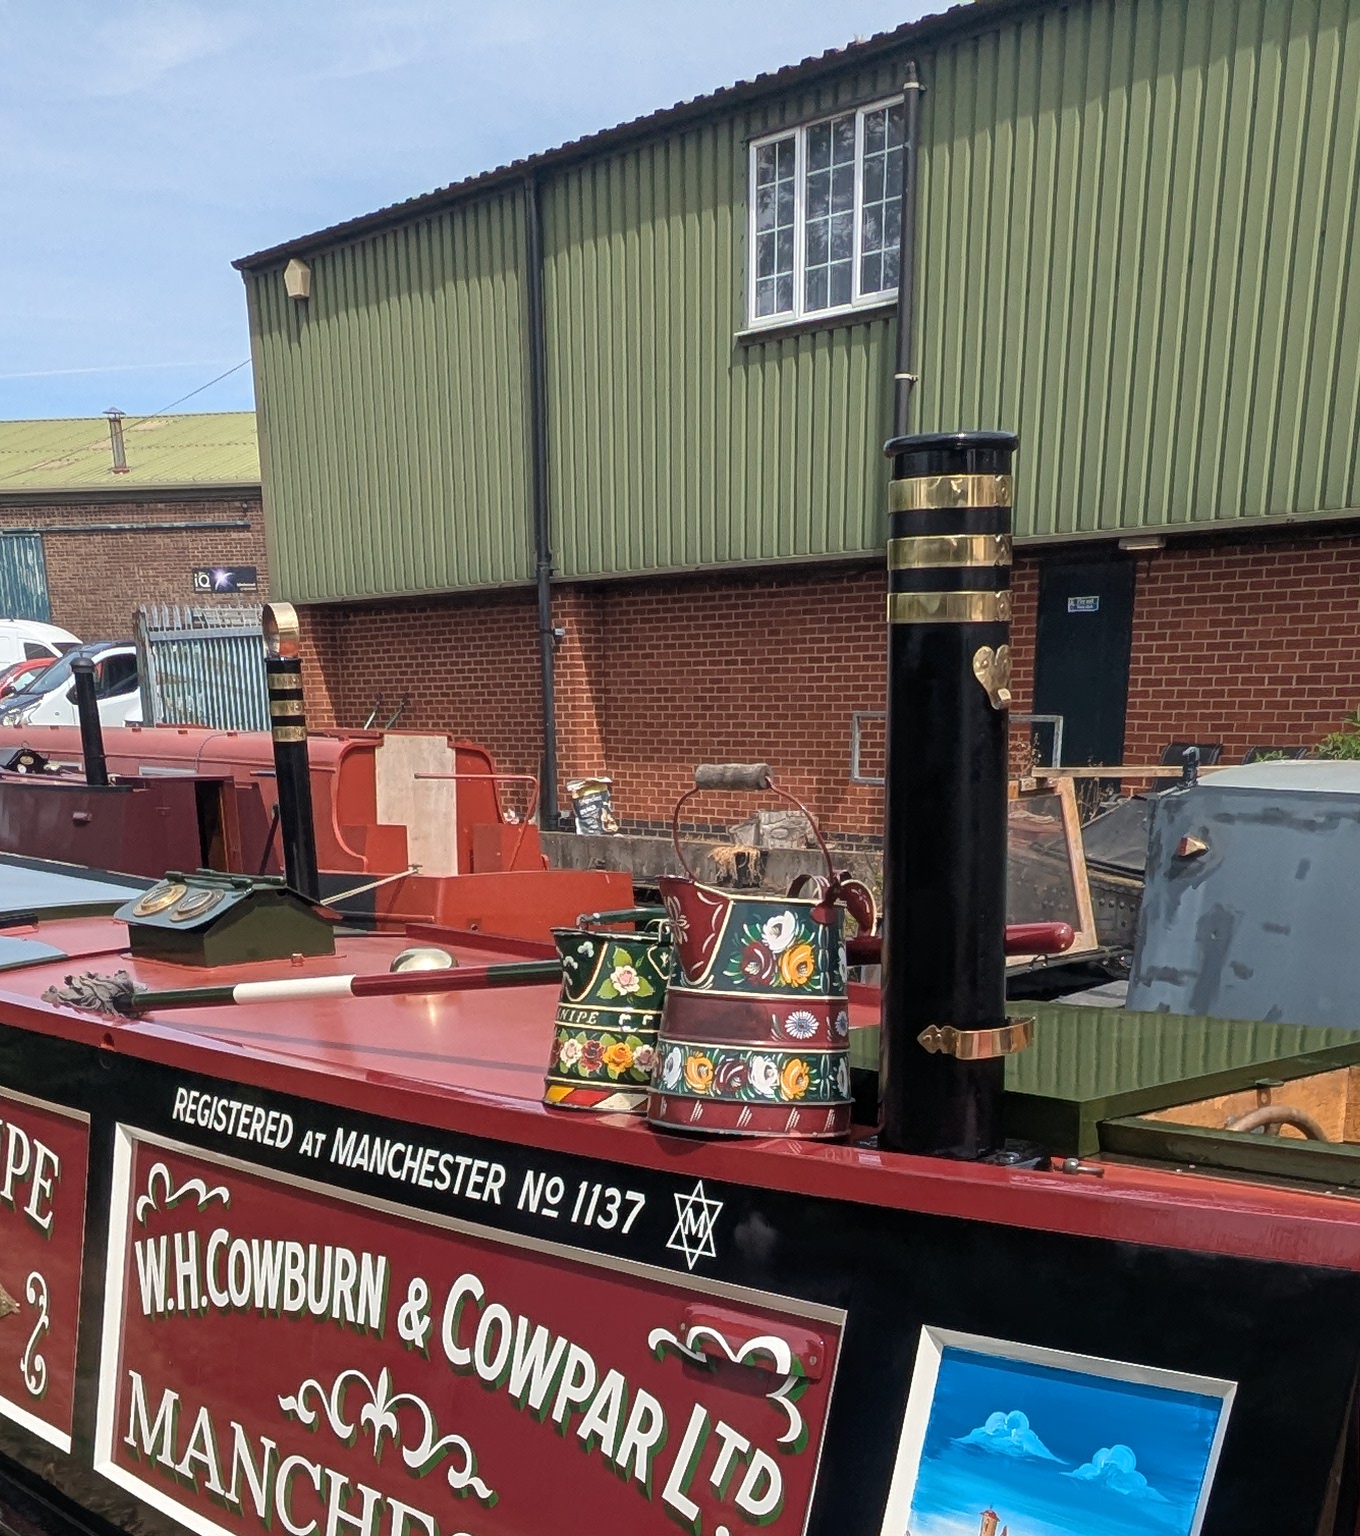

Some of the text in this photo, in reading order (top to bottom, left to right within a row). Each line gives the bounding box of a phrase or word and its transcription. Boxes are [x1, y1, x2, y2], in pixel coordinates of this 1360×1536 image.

[172, 1086, 293, 1149] REGISTERED
[330, 1127, 506, 1205] MANCHESTER
[570, 1180, 646, 1234] 1137
[683, 1207, 708, 1239] M
[397, 1276, 430, 1348] &
[442, 1273, 664, 1484] COWPAR
